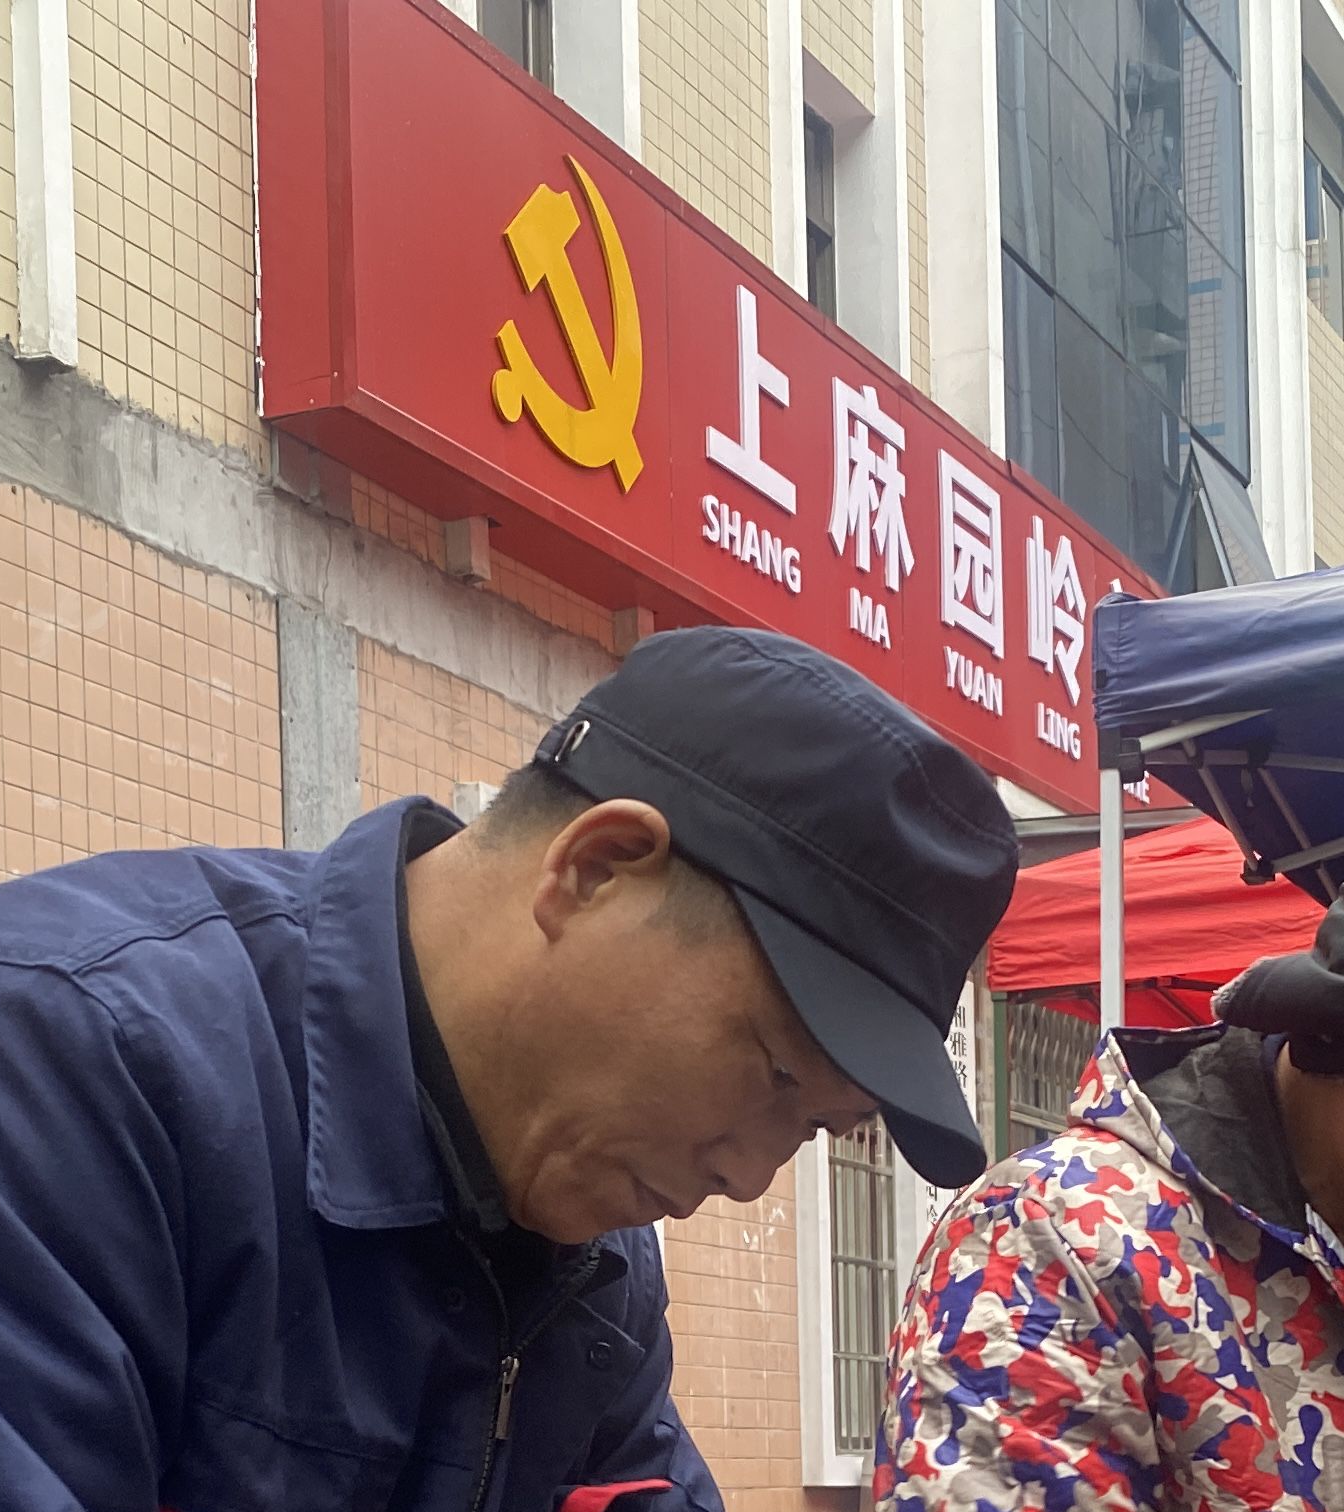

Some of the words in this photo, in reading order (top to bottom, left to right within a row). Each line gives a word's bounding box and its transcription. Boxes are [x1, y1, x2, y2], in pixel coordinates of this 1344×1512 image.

[702, 495, 801, 594] SHANG
[849, 587, 892, 650] MA
[943, 645, 1003, 717] YUAN
[1037, 702, 1081, 760] LING
[705, 284, 1087, 706] 上麻园岭
